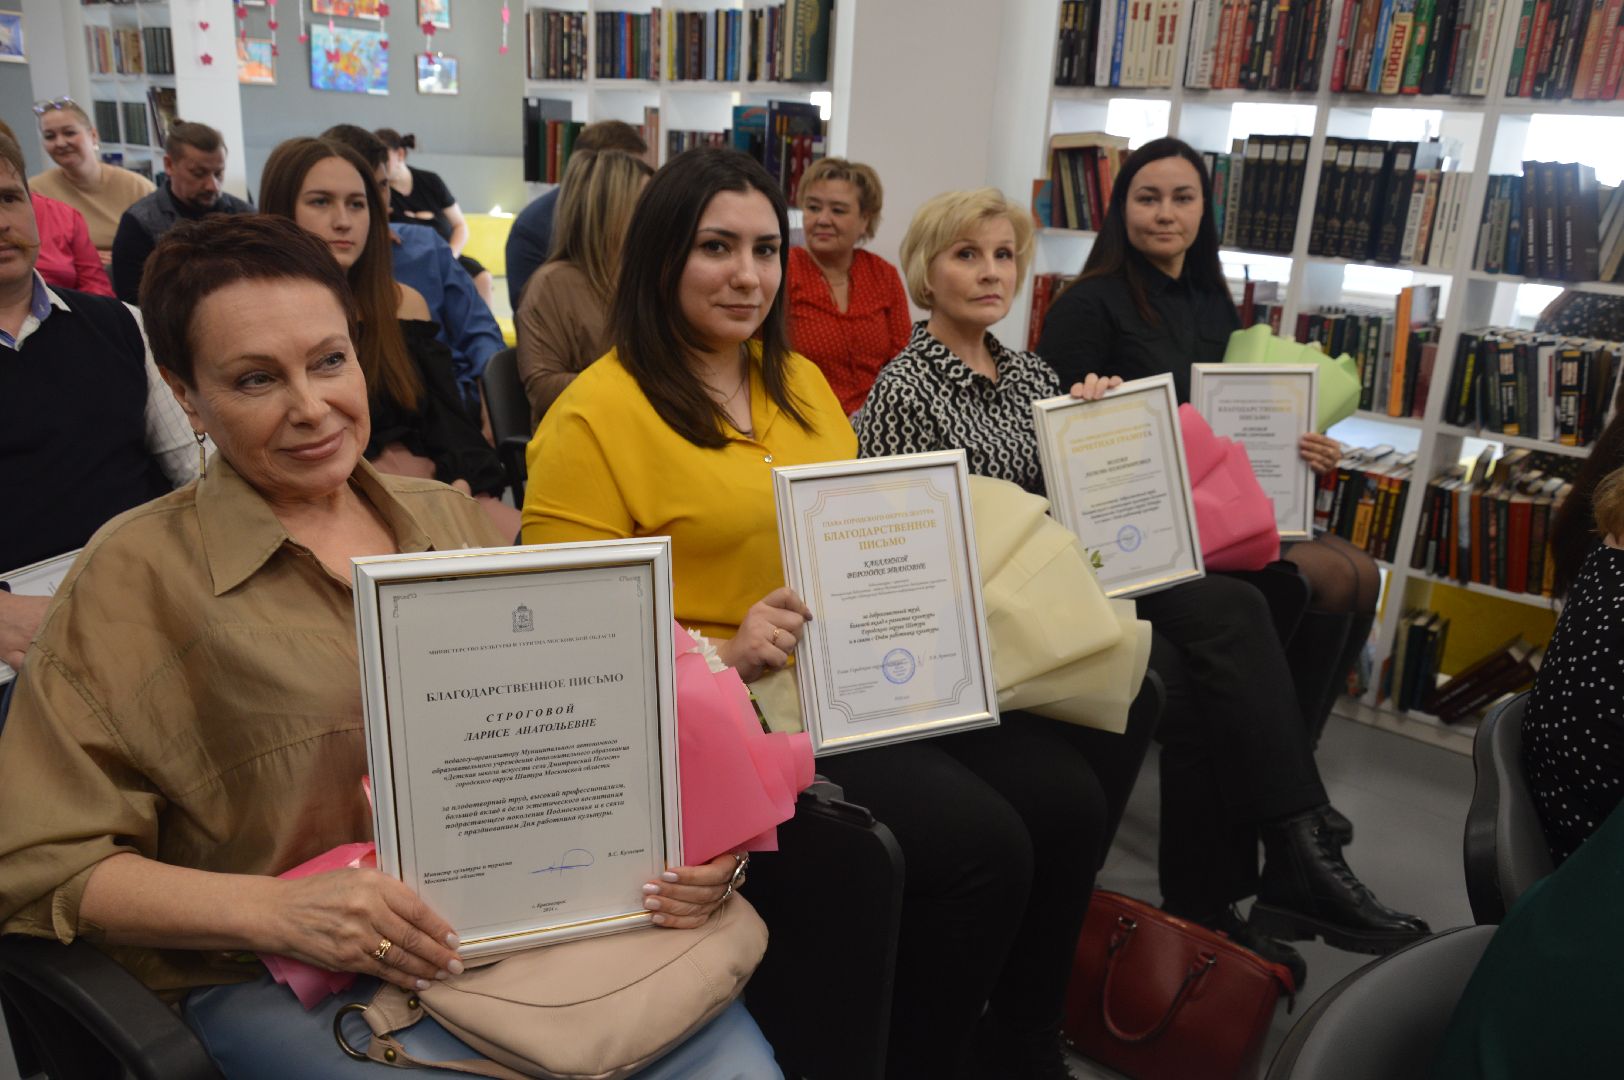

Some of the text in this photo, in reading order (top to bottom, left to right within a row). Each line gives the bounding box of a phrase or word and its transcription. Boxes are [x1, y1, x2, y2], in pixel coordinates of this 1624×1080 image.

[824, 520, 937, 542] БЛАГОДАРСТВЕННОЕ
[859, 537, 906, 551] ПИСЬМО
[426, 674, 623, 702] БЛАГОДАРСТВЕННОЕ ПИСЬМО
[486, 704, 574, 722] СТРОГОВОЙ
[464, 718, 596, 741] ЛАРИСЕ АНАТОЛЬЕВНЕ
[522, 745, 574, 755] Муниципального
[432, 763, 489, 773] образовательного
[494, 758, 532, 766] учреждения
[534, 751, 590, 761] дополнительного
[547, 758, 591, 767] Дмитровский
[451, 799, 506, 810] плодотворный
[562, 783, 624, 796] профессионализм,
[526, 798, 578, 808] эстетического
[581, 792, 623, 801] воспитания
[445, 818, 504, 829] подрастающего
[546, 805, 591, 814] Подмосковья
[464, 824, 518, 835] празднованием
[536, 815, 575, 826] работника
